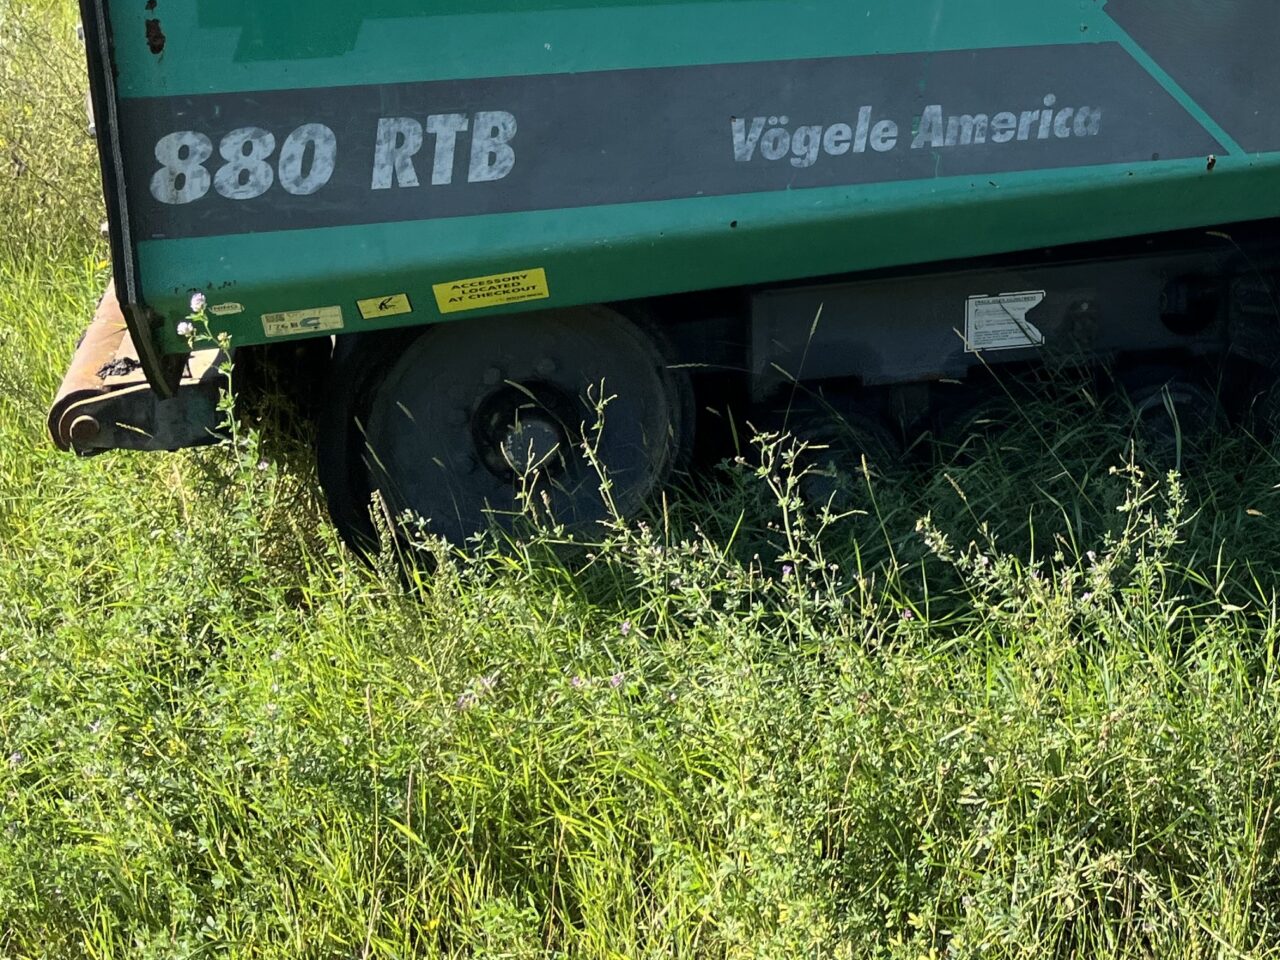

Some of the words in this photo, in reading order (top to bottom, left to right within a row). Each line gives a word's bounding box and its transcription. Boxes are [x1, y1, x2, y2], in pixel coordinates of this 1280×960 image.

[731, 105, 898, 168] Vögele
[910, 93, 1100, 149] America
[150, 123, 337, 205] 880
[371, 111, 517, 190] RTB
[451, 274, 528, 290] ACCESSORY
[461, 281, 521, 295] LOCATED
[468, 285, 537, 300] CHECKOUT
